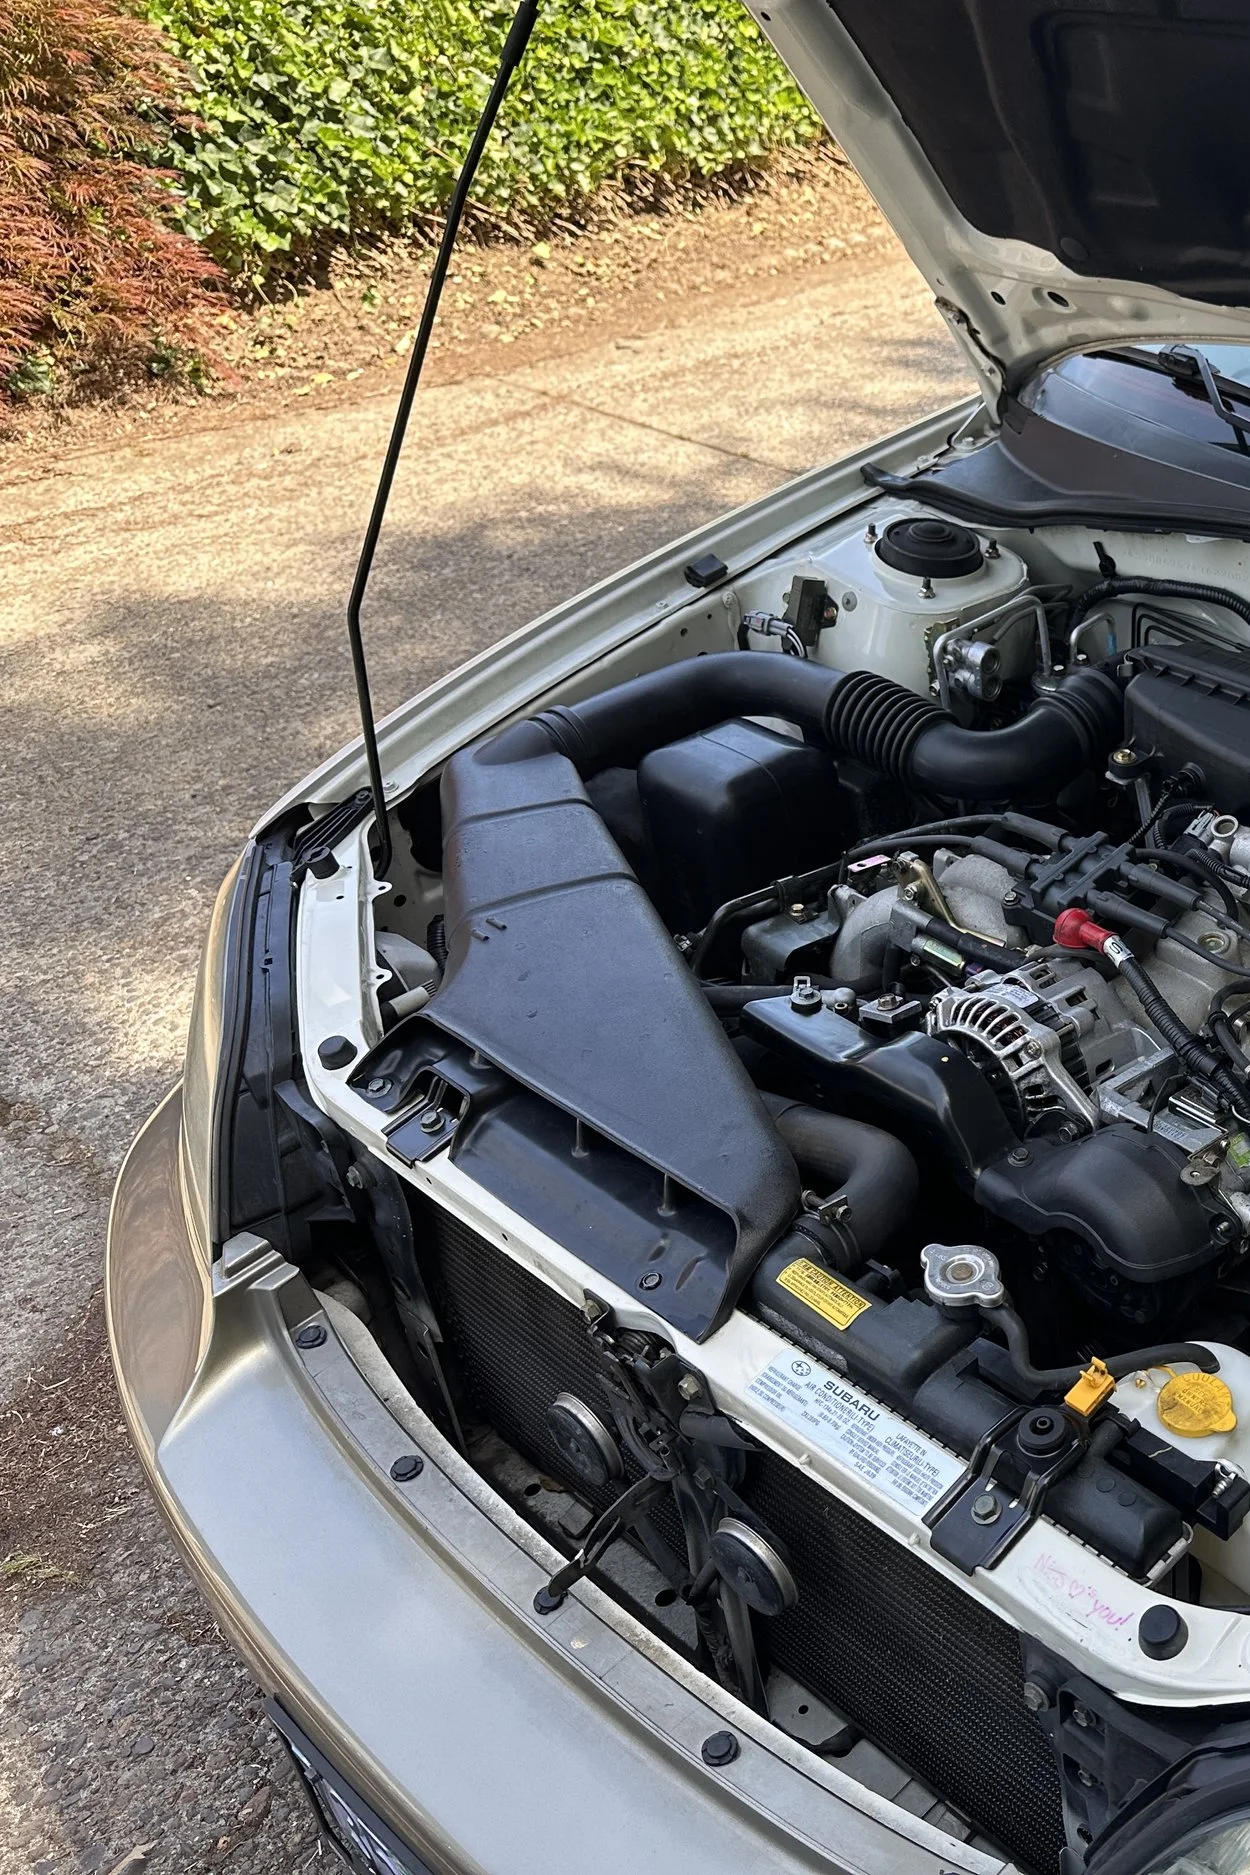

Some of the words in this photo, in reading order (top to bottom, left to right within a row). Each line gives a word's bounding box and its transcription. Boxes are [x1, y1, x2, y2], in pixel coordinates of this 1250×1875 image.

[804, 1380, 816, 1391] AIR
[821, 1380, 881, 1421] SUBARU
[1177, 1394, 1202, 1413] MANUAL
[1086, 1599, 1135, 1632] you!
